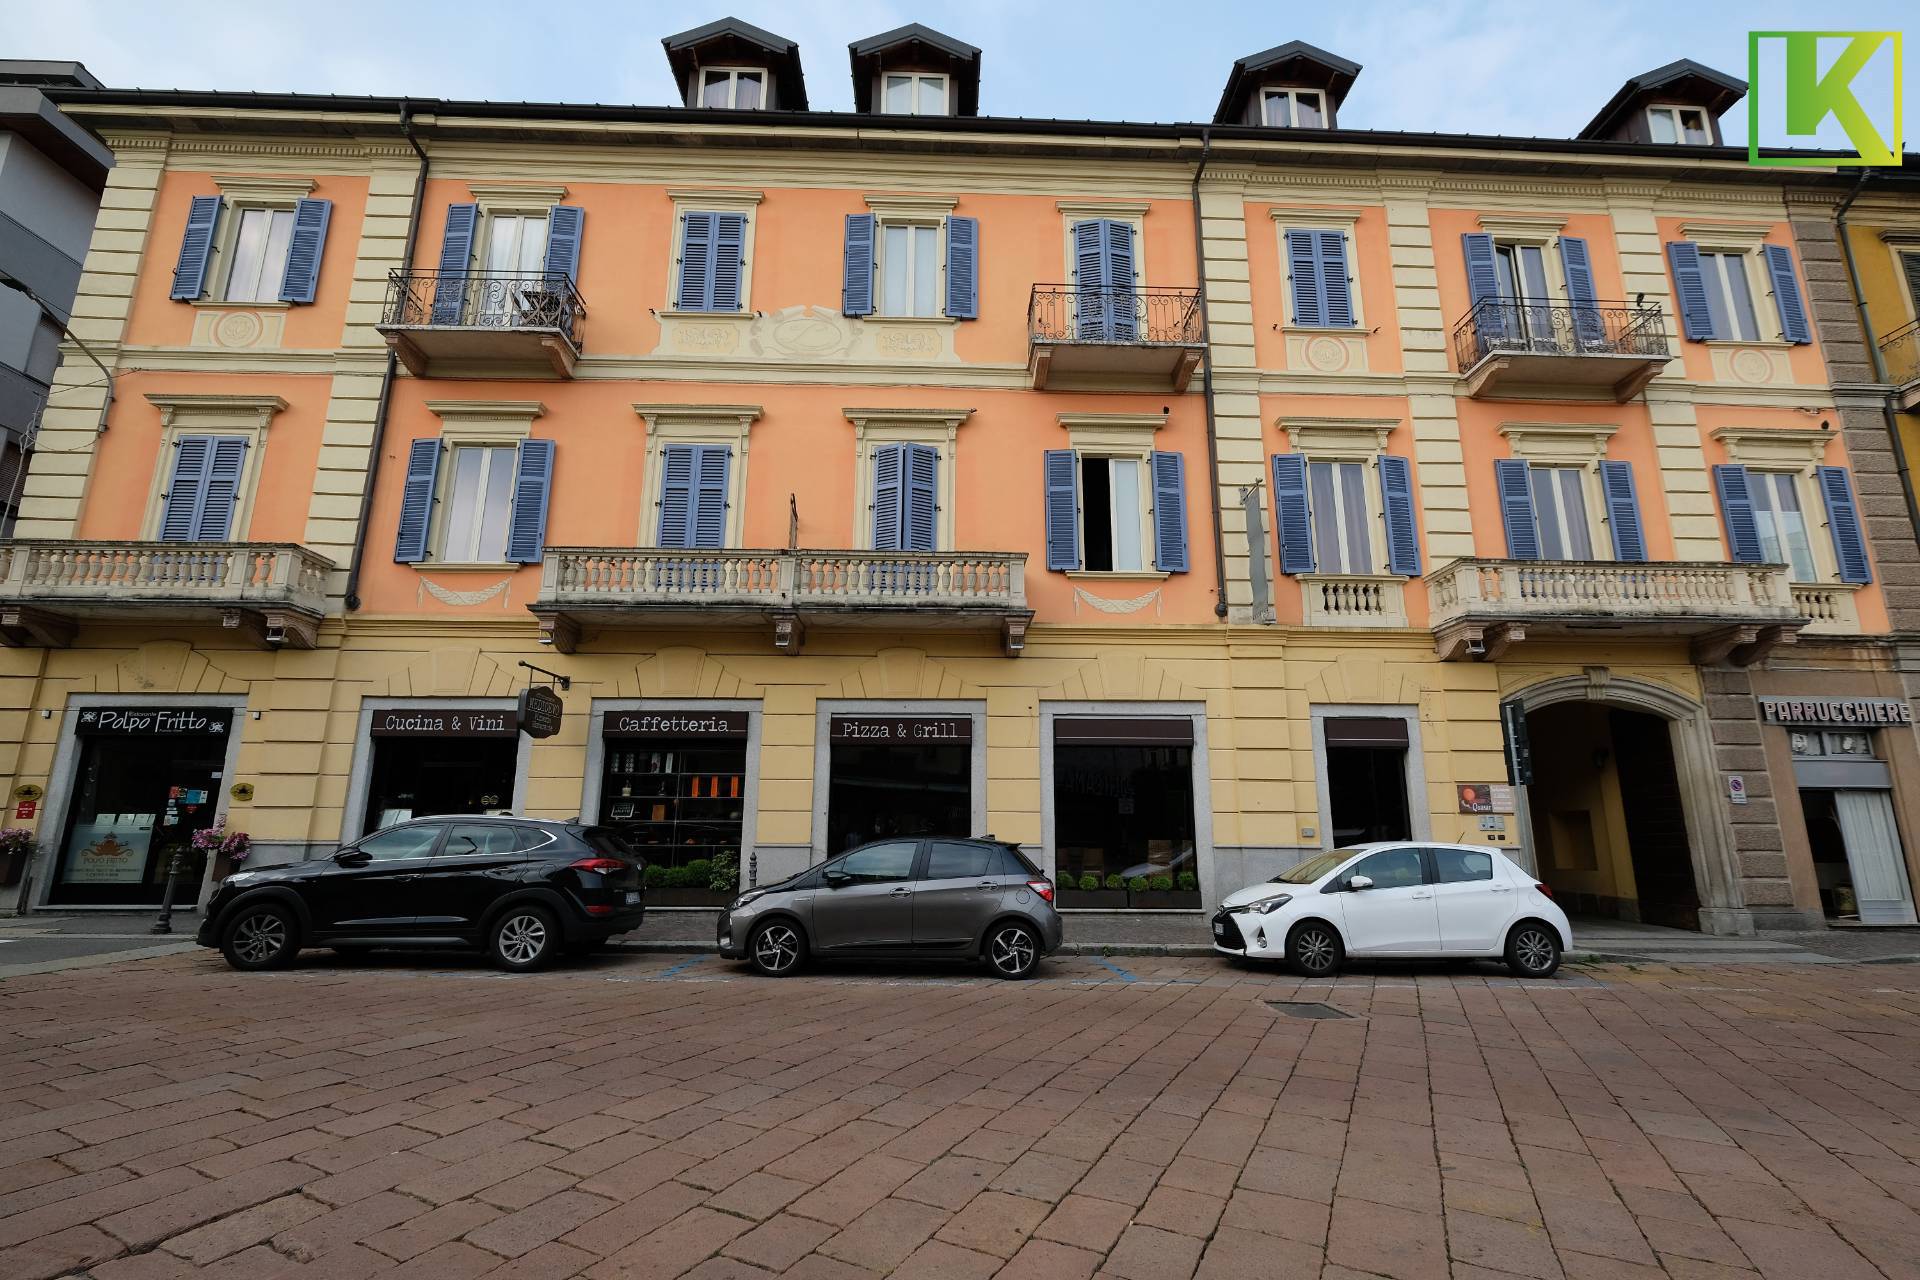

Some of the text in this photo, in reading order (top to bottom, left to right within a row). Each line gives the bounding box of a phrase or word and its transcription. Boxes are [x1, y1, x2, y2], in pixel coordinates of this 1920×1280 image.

[1764, 702, 1912, 722] PARRUCCHIERE
[98, 711, 207, 733] Polpo Fritto
[386, 714, 505, 731] Cucina & Vini
[619, 716, 729, 732] Caffetteria
[842, 721, 958, 738] Pizza & Grill
